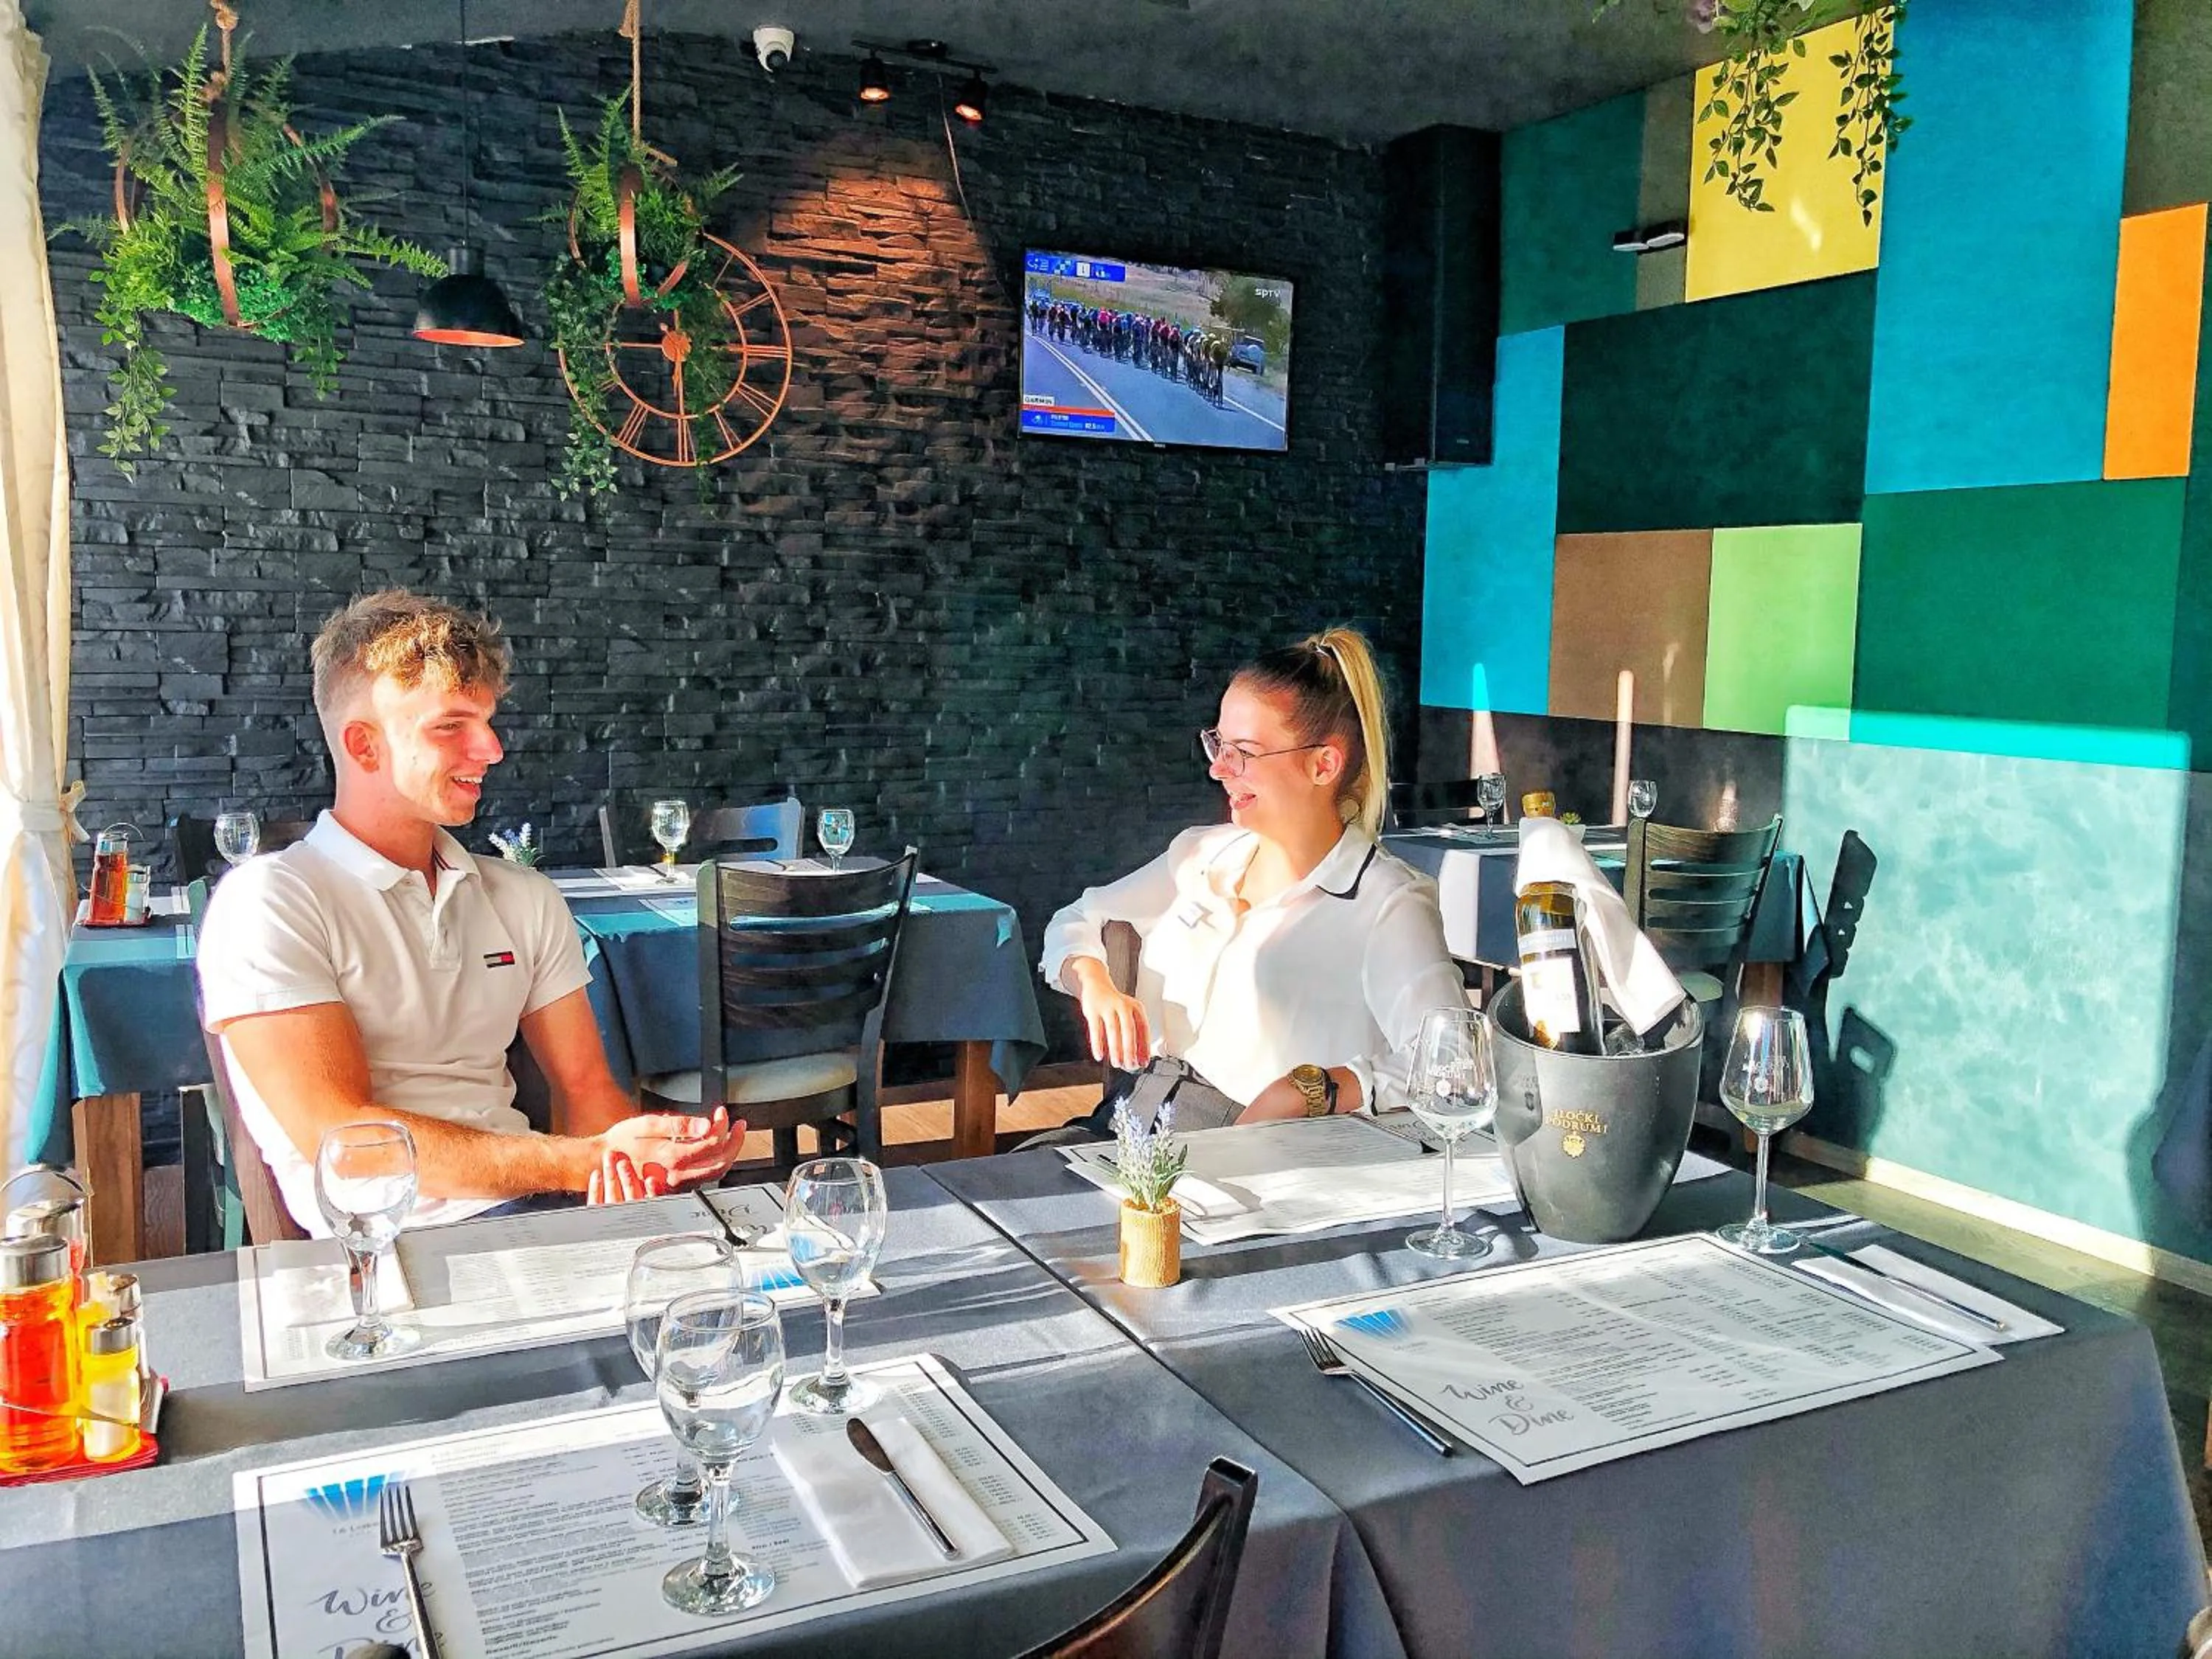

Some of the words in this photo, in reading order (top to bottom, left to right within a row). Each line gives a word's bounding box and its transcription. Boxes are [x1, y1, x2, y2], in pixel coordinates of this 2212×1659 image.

[1545, 1116, 1608, 1133] PODRUMI
[1439, 1379, 1524, 1400] Wine
[1504, 1395, 1534, 1411] &
[1488, 1410, 1574, 1436] Dine
